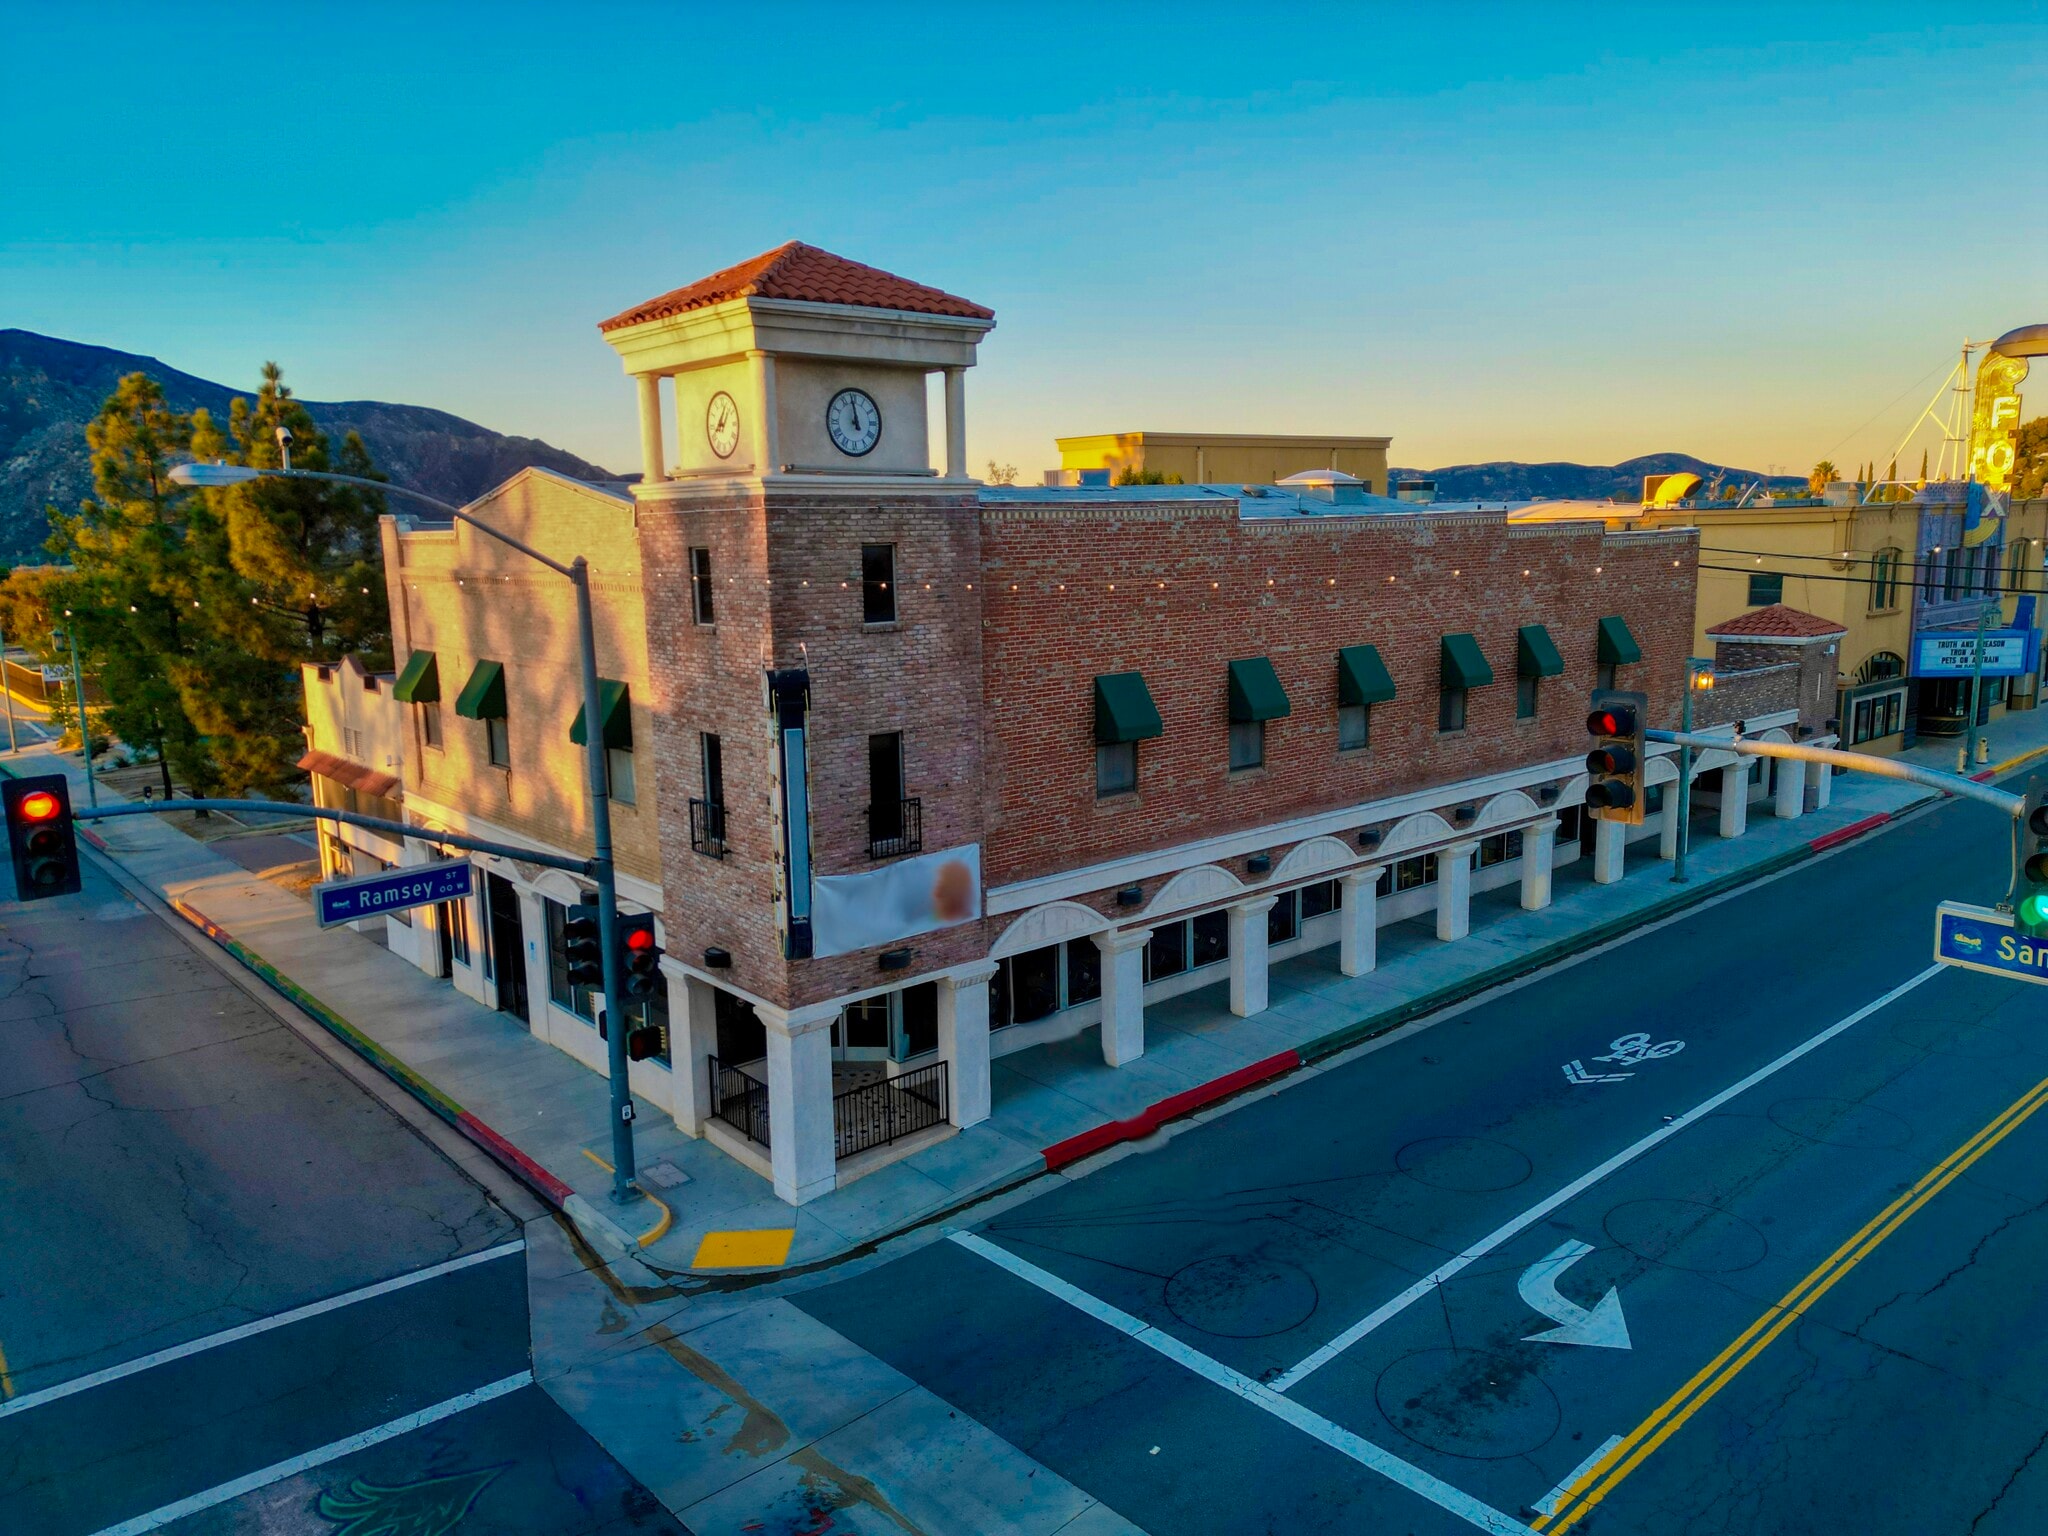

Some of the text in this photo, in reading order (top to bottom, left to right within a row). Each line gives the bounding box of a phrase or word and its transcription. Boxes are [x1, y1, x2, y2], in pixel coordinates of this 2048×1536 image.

[1981, 396, 2020, 517] FOX
[445, 871, 457, 880] ST
[359, 881, 433, 908] Ramsey
